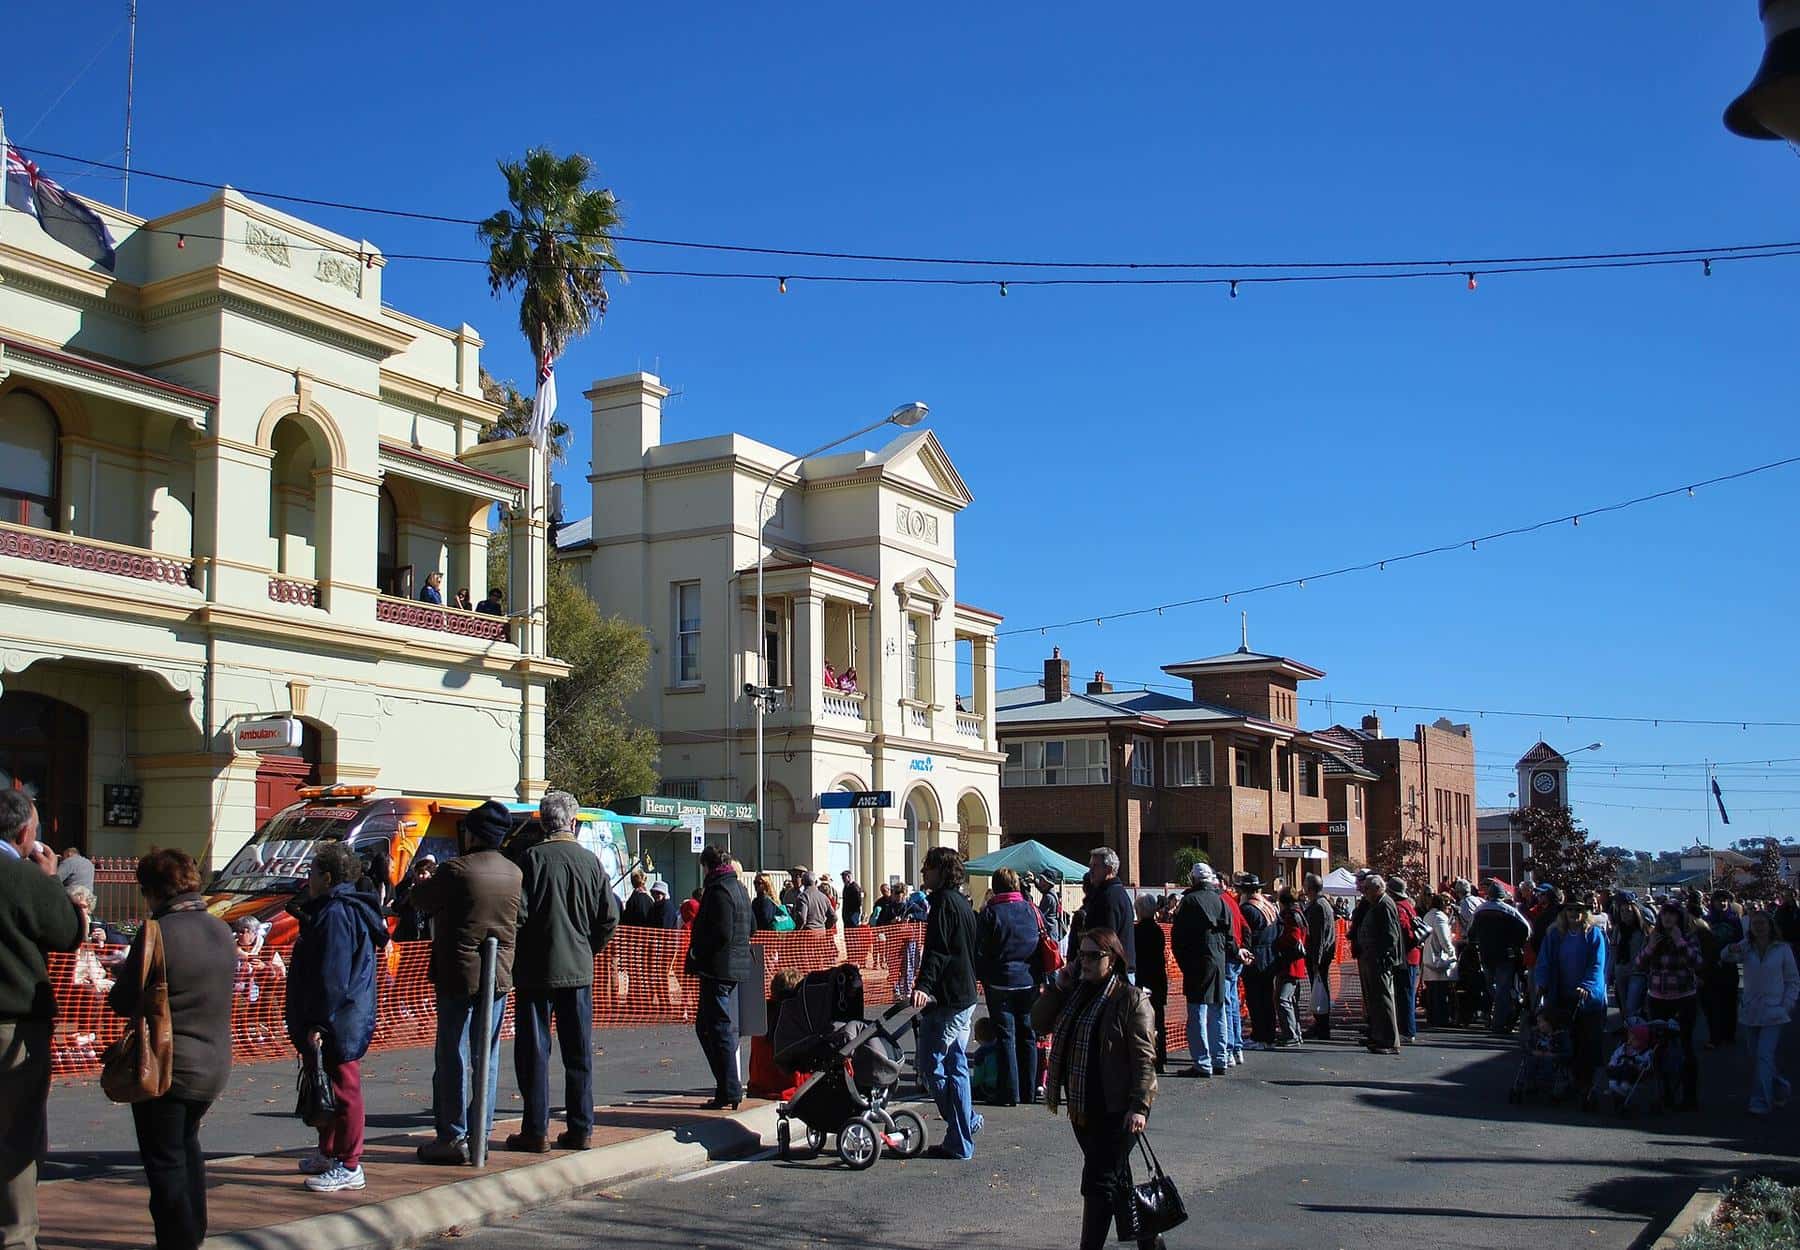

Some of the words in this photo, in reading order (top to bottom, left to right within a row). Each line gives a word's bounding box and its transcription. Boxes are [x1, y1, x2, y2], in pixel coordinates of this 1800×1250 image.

[909, 759, 925, 771] ANZ
[857, 797, 878, 806] ANZ
[309, 809, 355, 819] CHILDREN
[646, 800, 675, 815] Henry
[677, 802, 706, 815] Lawson
[710, 804, 727, 817] 1867
[736, 806, 752, 818] 1922
[1329, 823, 1346, 833] nab
[231, 857, 312, 876] Coffee
